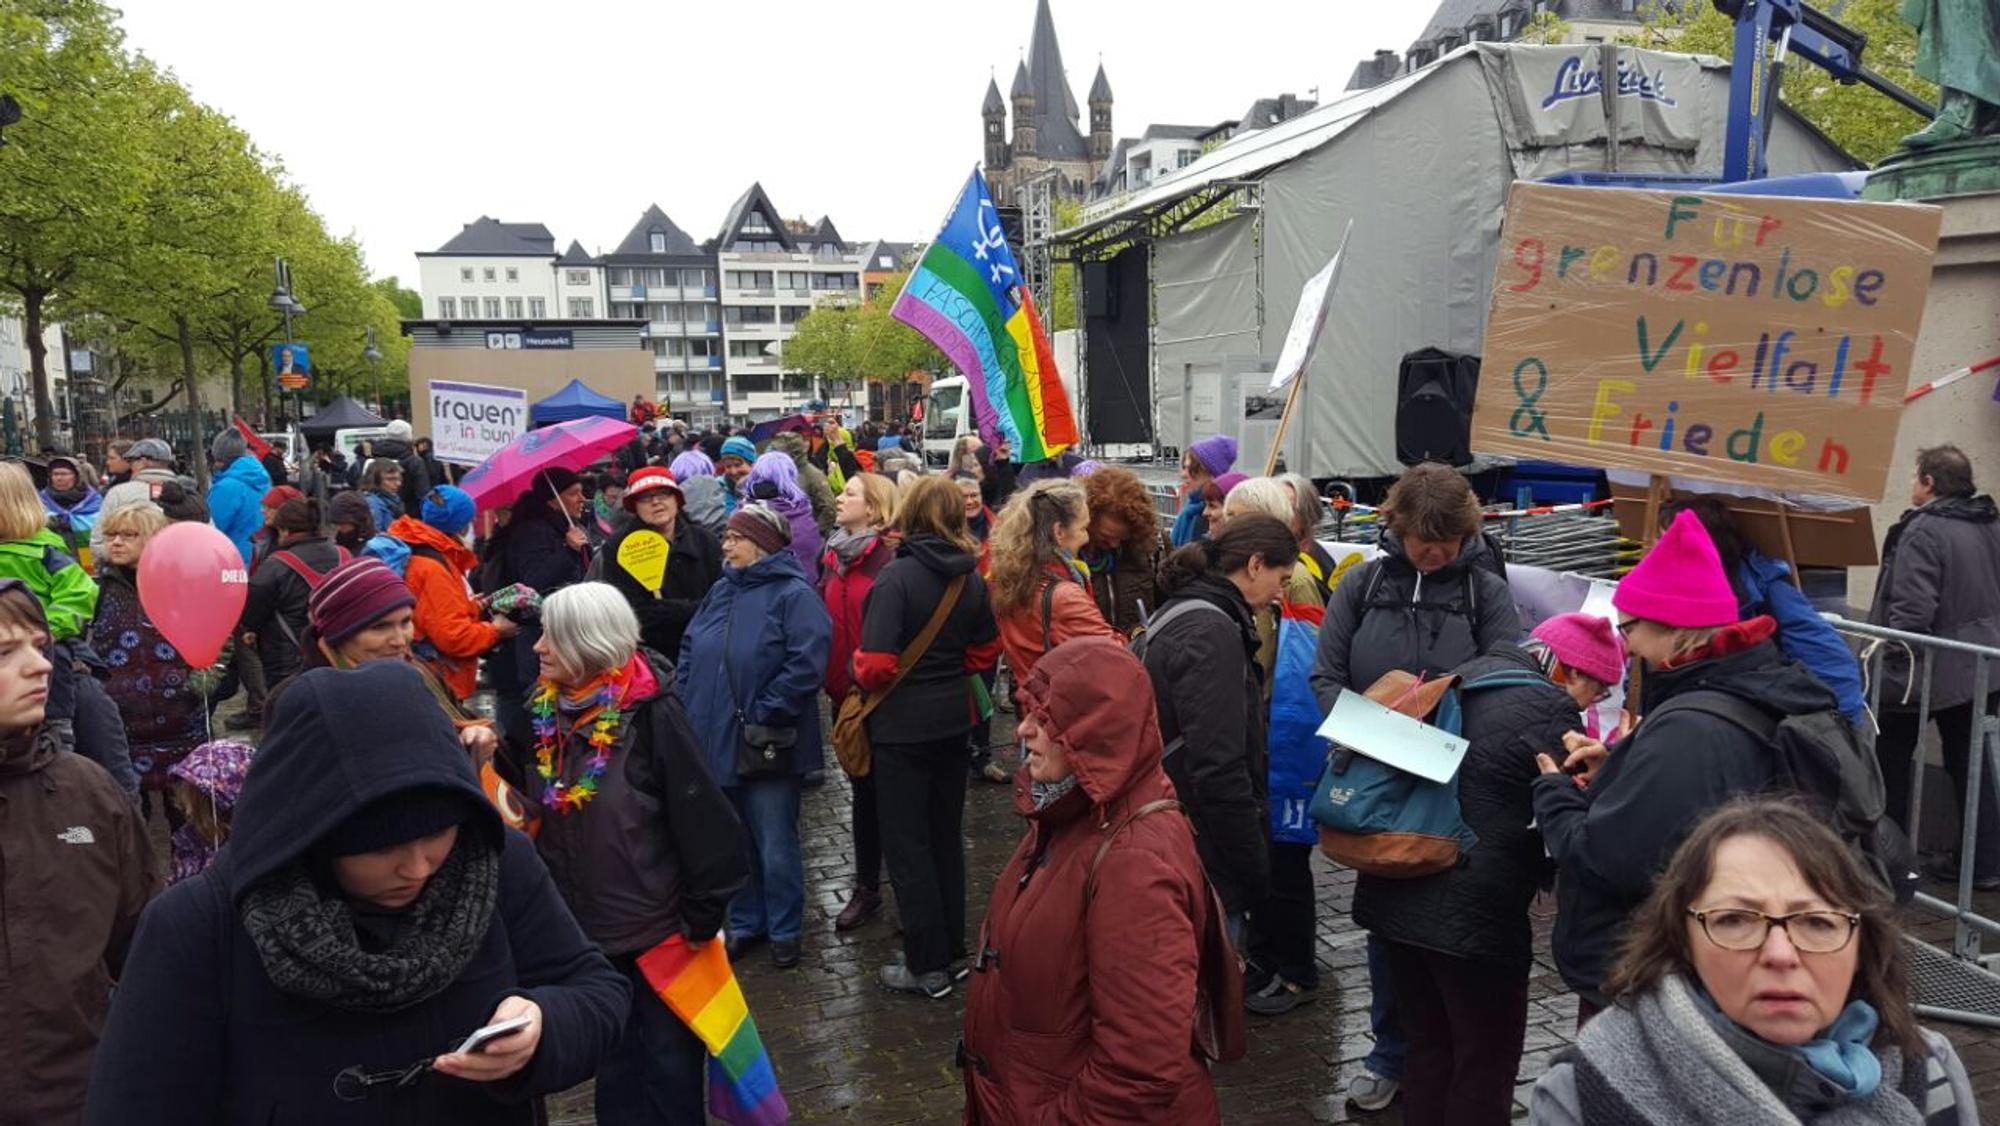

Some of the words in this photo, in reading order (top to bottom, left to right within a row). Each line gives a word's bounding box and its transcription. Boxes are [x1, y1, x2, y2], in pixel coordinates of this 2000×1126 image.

[1664, 196, 1782, 249] Für
[1509, 238, 1885, 308] grenzenlose
[1637, 315, 1892, 406] Vielfalt
[460, 422, 475, 439] in
[1509, 357, 1552, 441] &
[1587, 379, 1851, 475] Frieden
